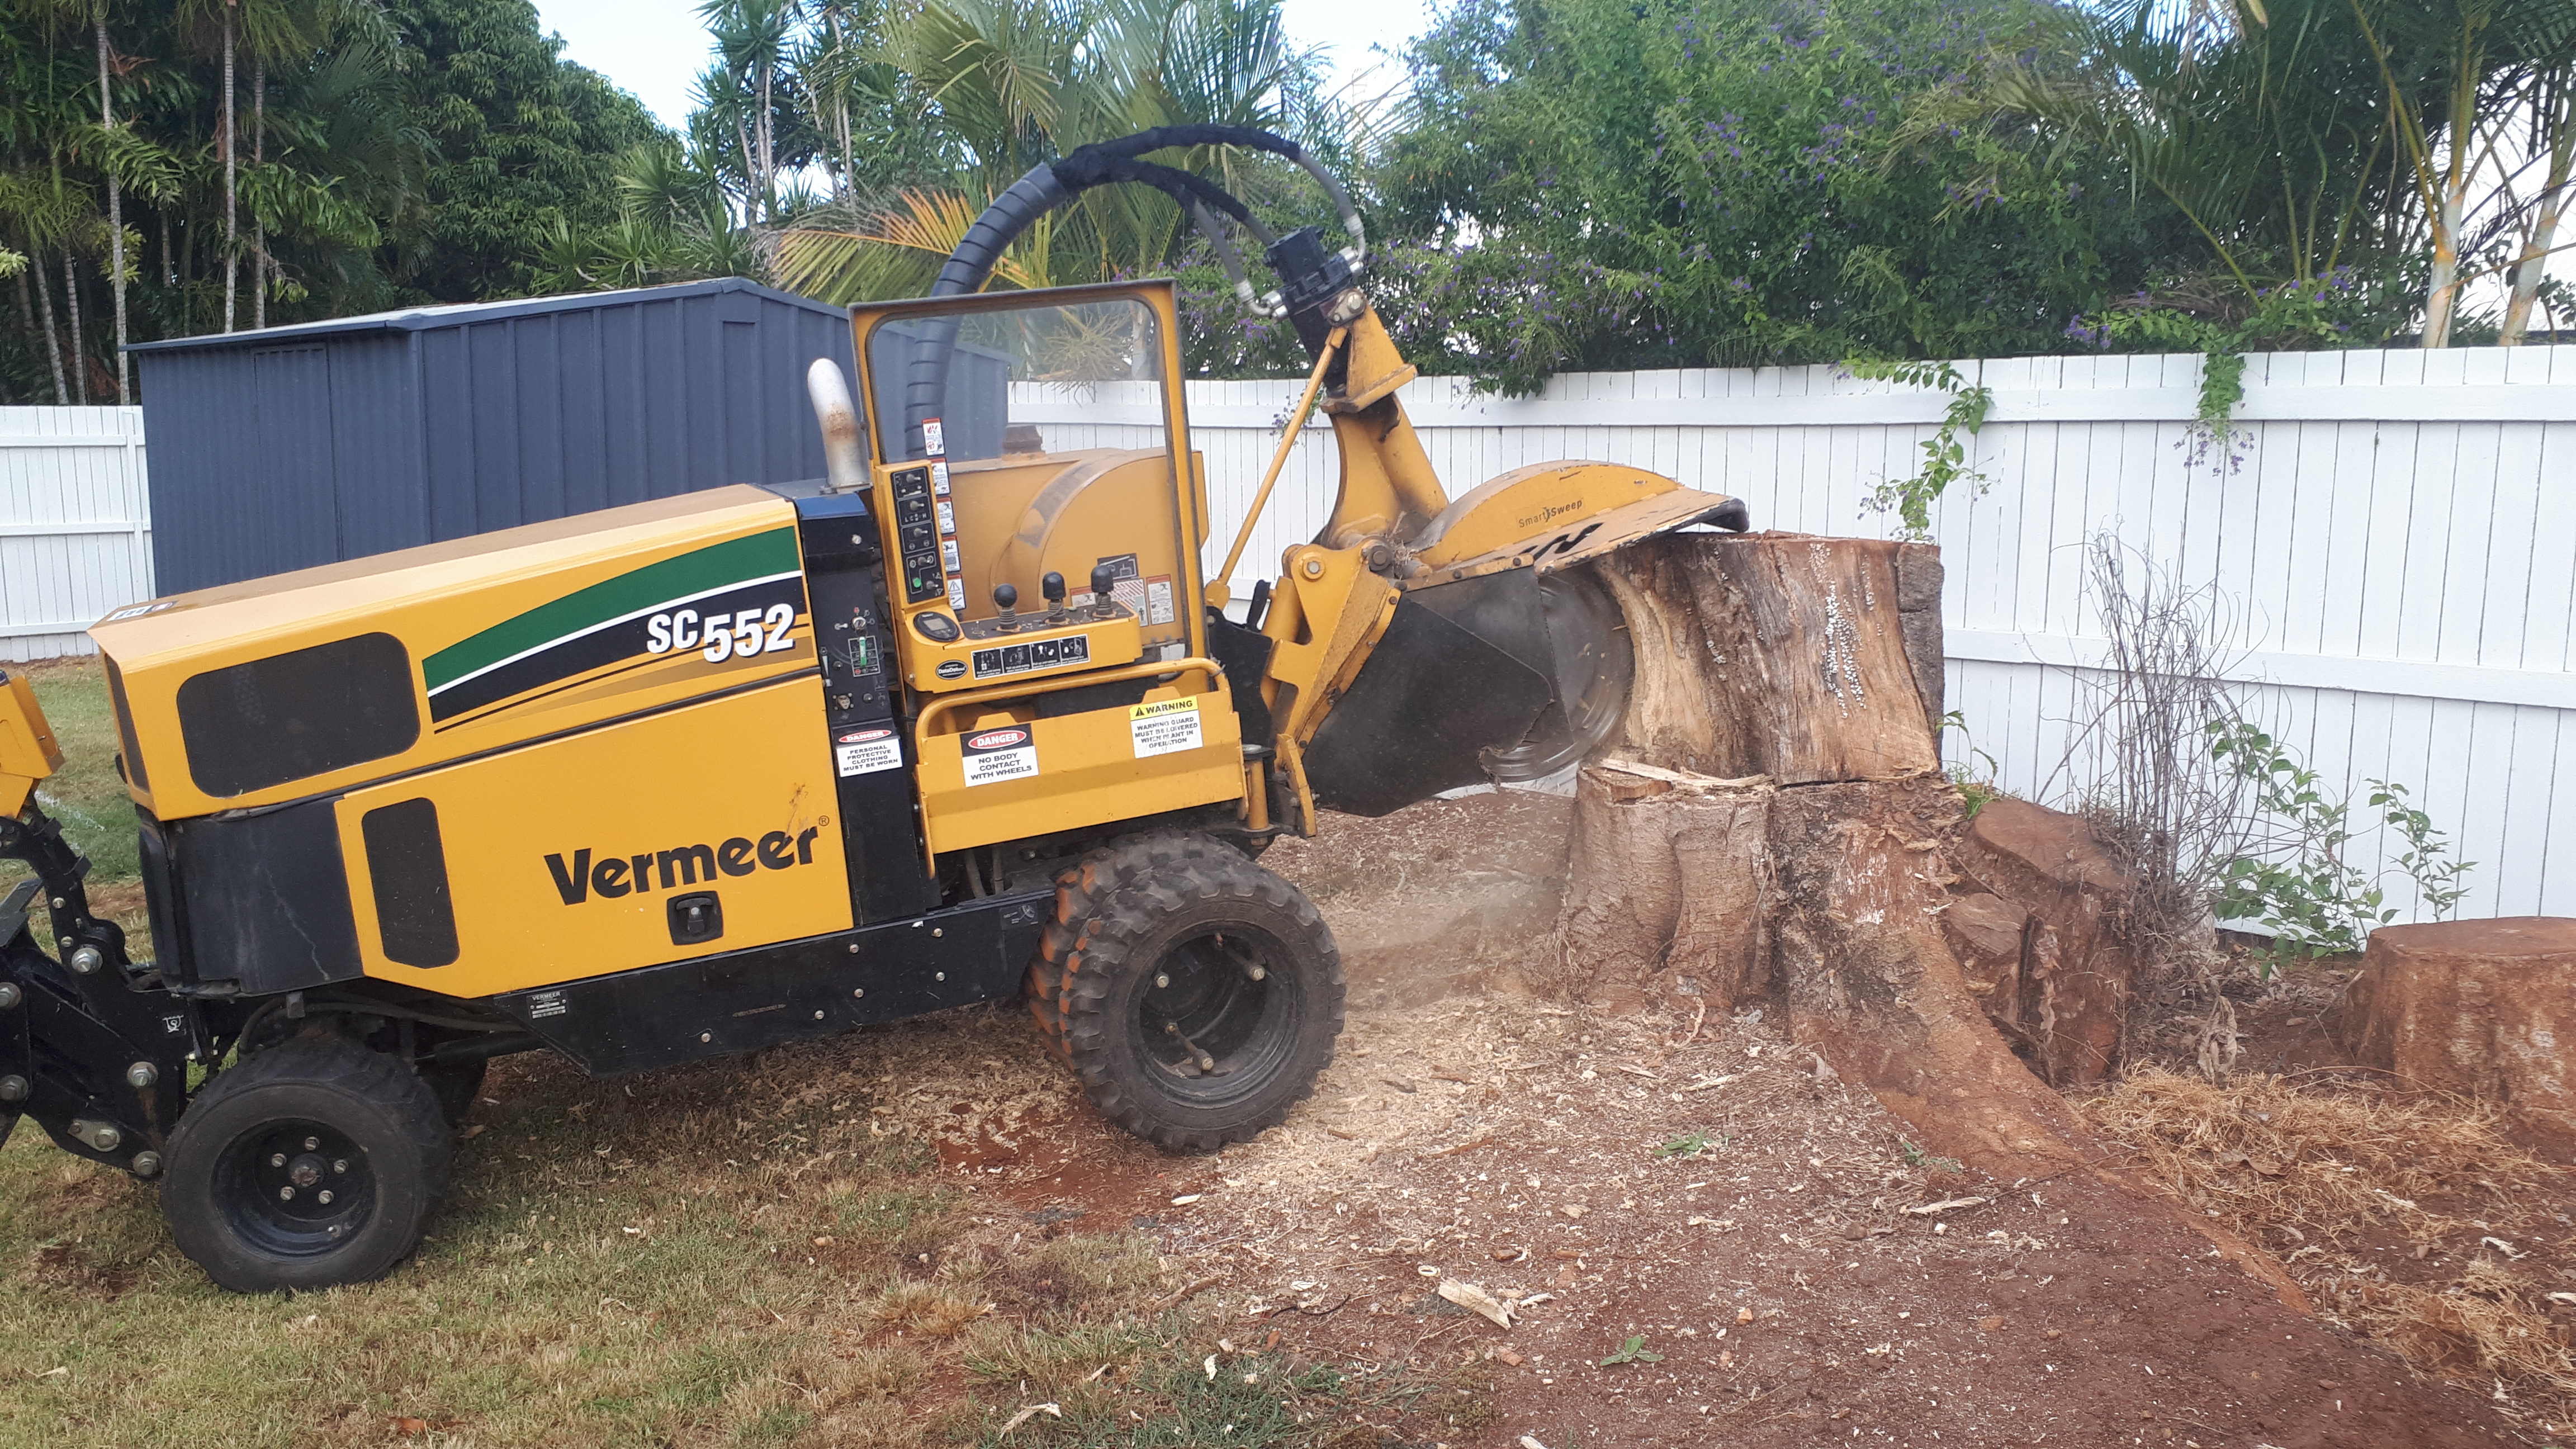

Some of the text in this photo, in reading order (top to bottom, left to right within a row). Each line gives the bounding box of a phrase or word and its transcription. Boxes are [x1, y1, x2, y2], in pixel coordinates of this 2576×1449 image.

[1145, 700, 1193, 714] WARNING
[1137, 721, 1169, 731] WARNING
[846, 731, 884, 741] DANGER
[977, 733, 1019, 746] DANGER
[1149, 737, 1187, 748] OPERTION
[847, 749, 892, 760] PROTECTIVE
[850, 745, 888, 755] PERSONAL
[852, 755, 888, 765] CLOTHING
[994, 752, 1018, 762] BODY
[979, 759, 1021, 771] CONTACT
[970, 765, 1032, 780] WITH WHEELS
